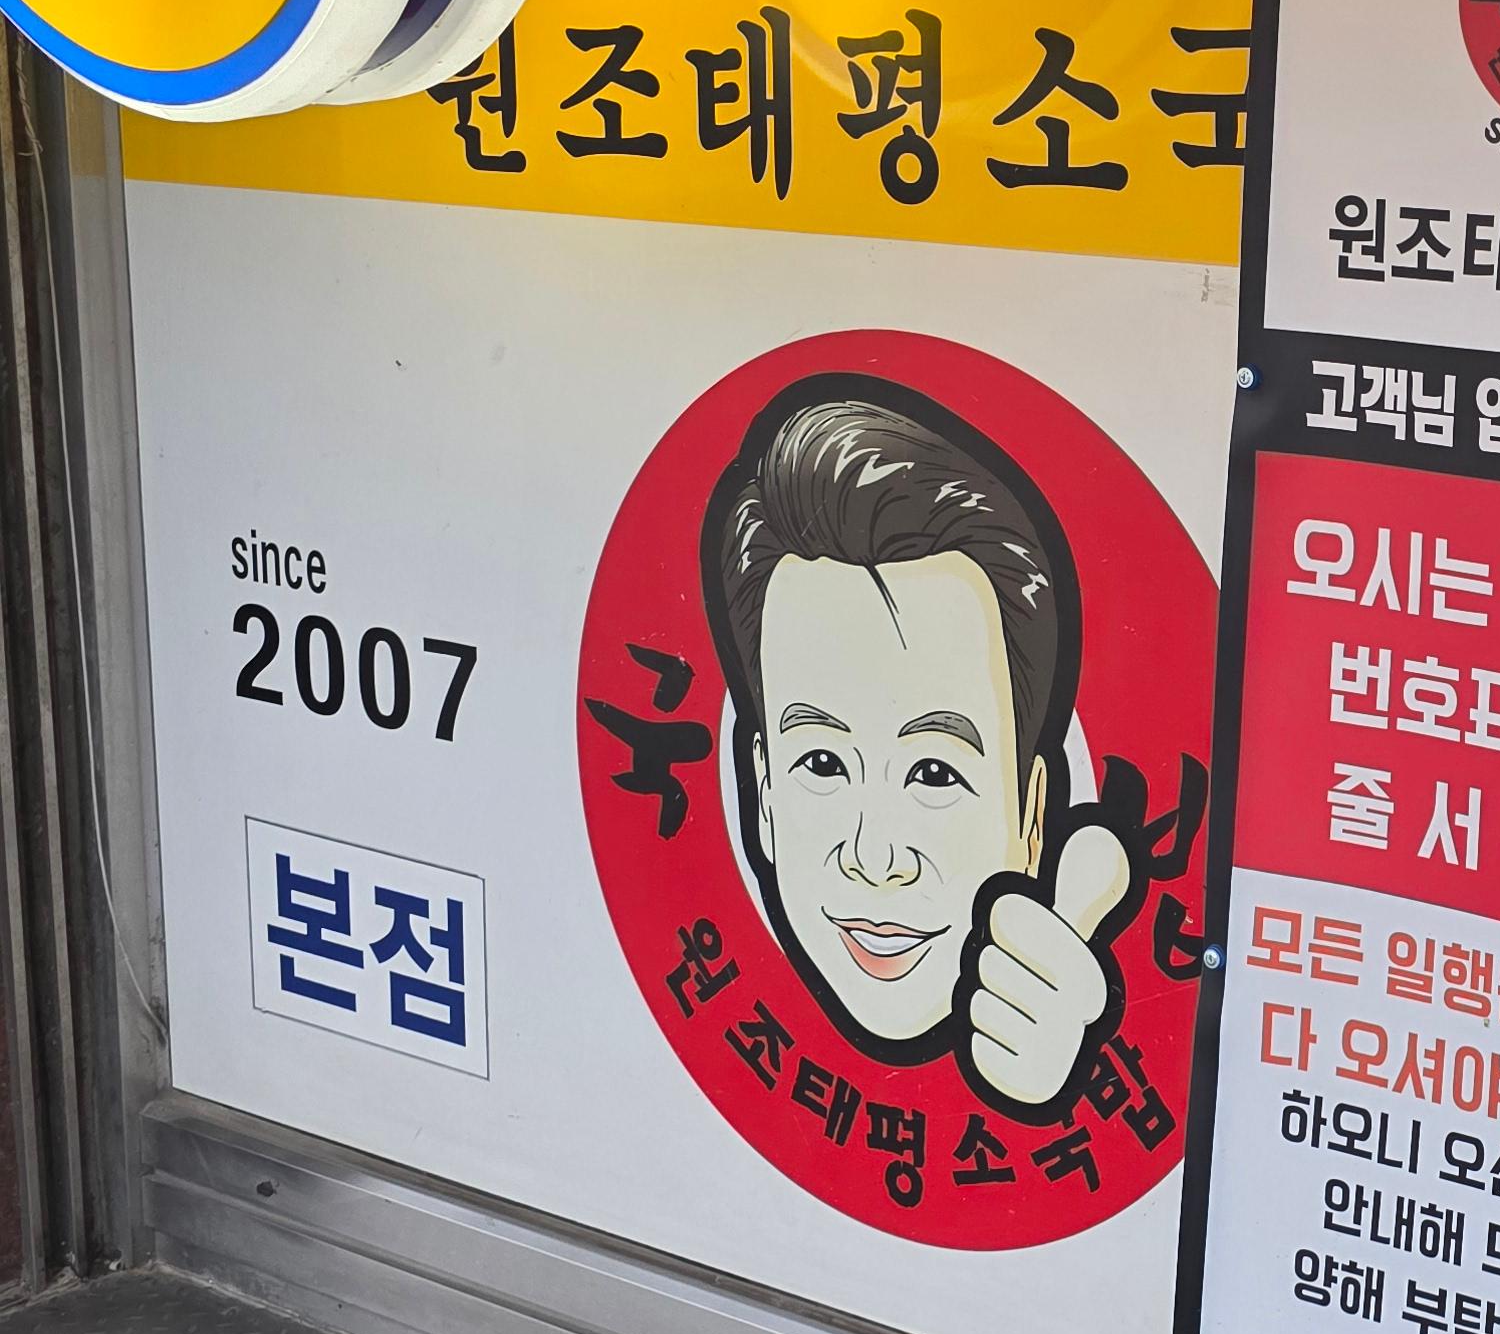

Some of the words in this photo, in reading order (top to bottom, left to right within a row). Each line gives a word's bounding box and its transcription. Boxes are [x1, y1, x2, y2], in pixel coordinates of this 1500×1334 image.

[1305, 358, 1458, 448] 고객님
[231, 529, 327, 594] since
[1285, 518, 1495, 628] 오시는
[232, 602, 478, 743] 2007
[1326, 761, 1395, 851] 줄
[1416, 779, 1482, 872] 서
[266, 852, 467, 1048] 본점
[1246, 905, 1364, 987] 모든
[1259, 1001, 1320, 1073] 다
[1280, 1087, 1421, 1175] 하오니
[1322, 1179, 1465, 1267] 안내해
[1292, 1248, 1384, 1325] 양해
